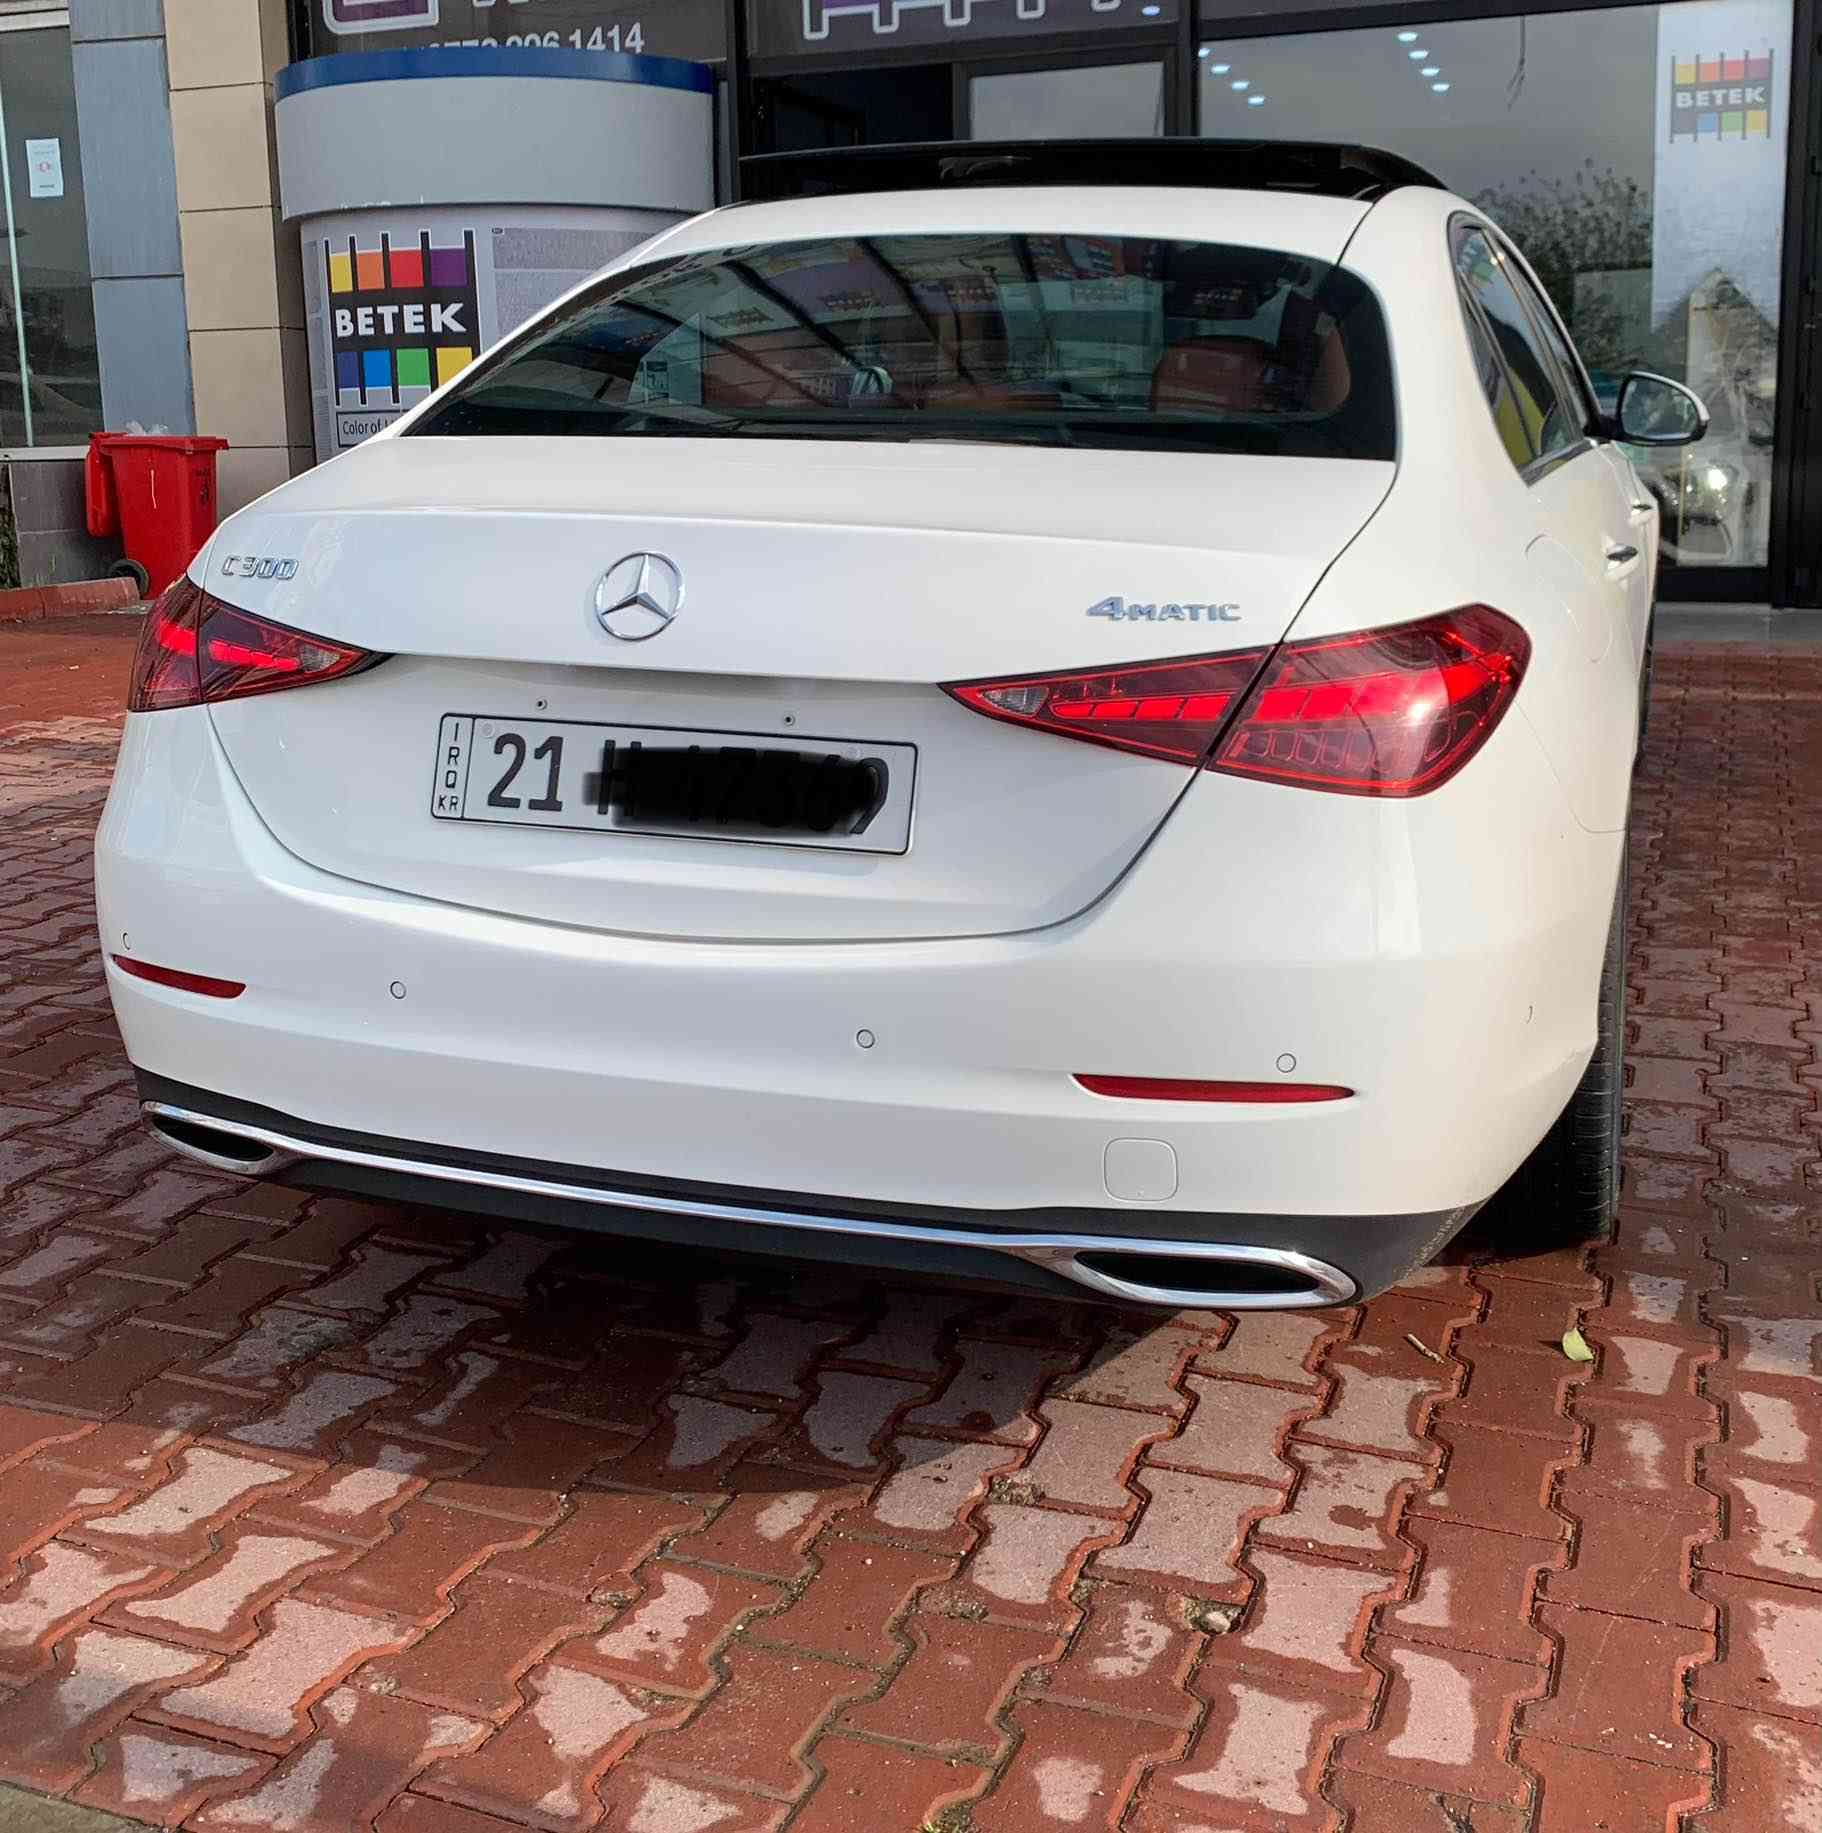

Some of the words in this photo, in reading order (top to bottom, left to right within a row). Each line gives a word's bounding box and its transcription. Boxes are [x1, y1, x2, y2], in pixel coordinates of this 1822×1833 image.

[569, 22, 645, 54] 1414
[1675, 86, 1766, 108] BETEK
[336, 303, 467, 338] BETEK
[342, 420, 368, 435] Color
[370, 419, 381, 434] of
[222, 555, 299, 581] C300
[1086, 596, 1243, 622] 4MATIC
[488, 733, 563, 811] 21
[438, 794, 459, 811] KR
